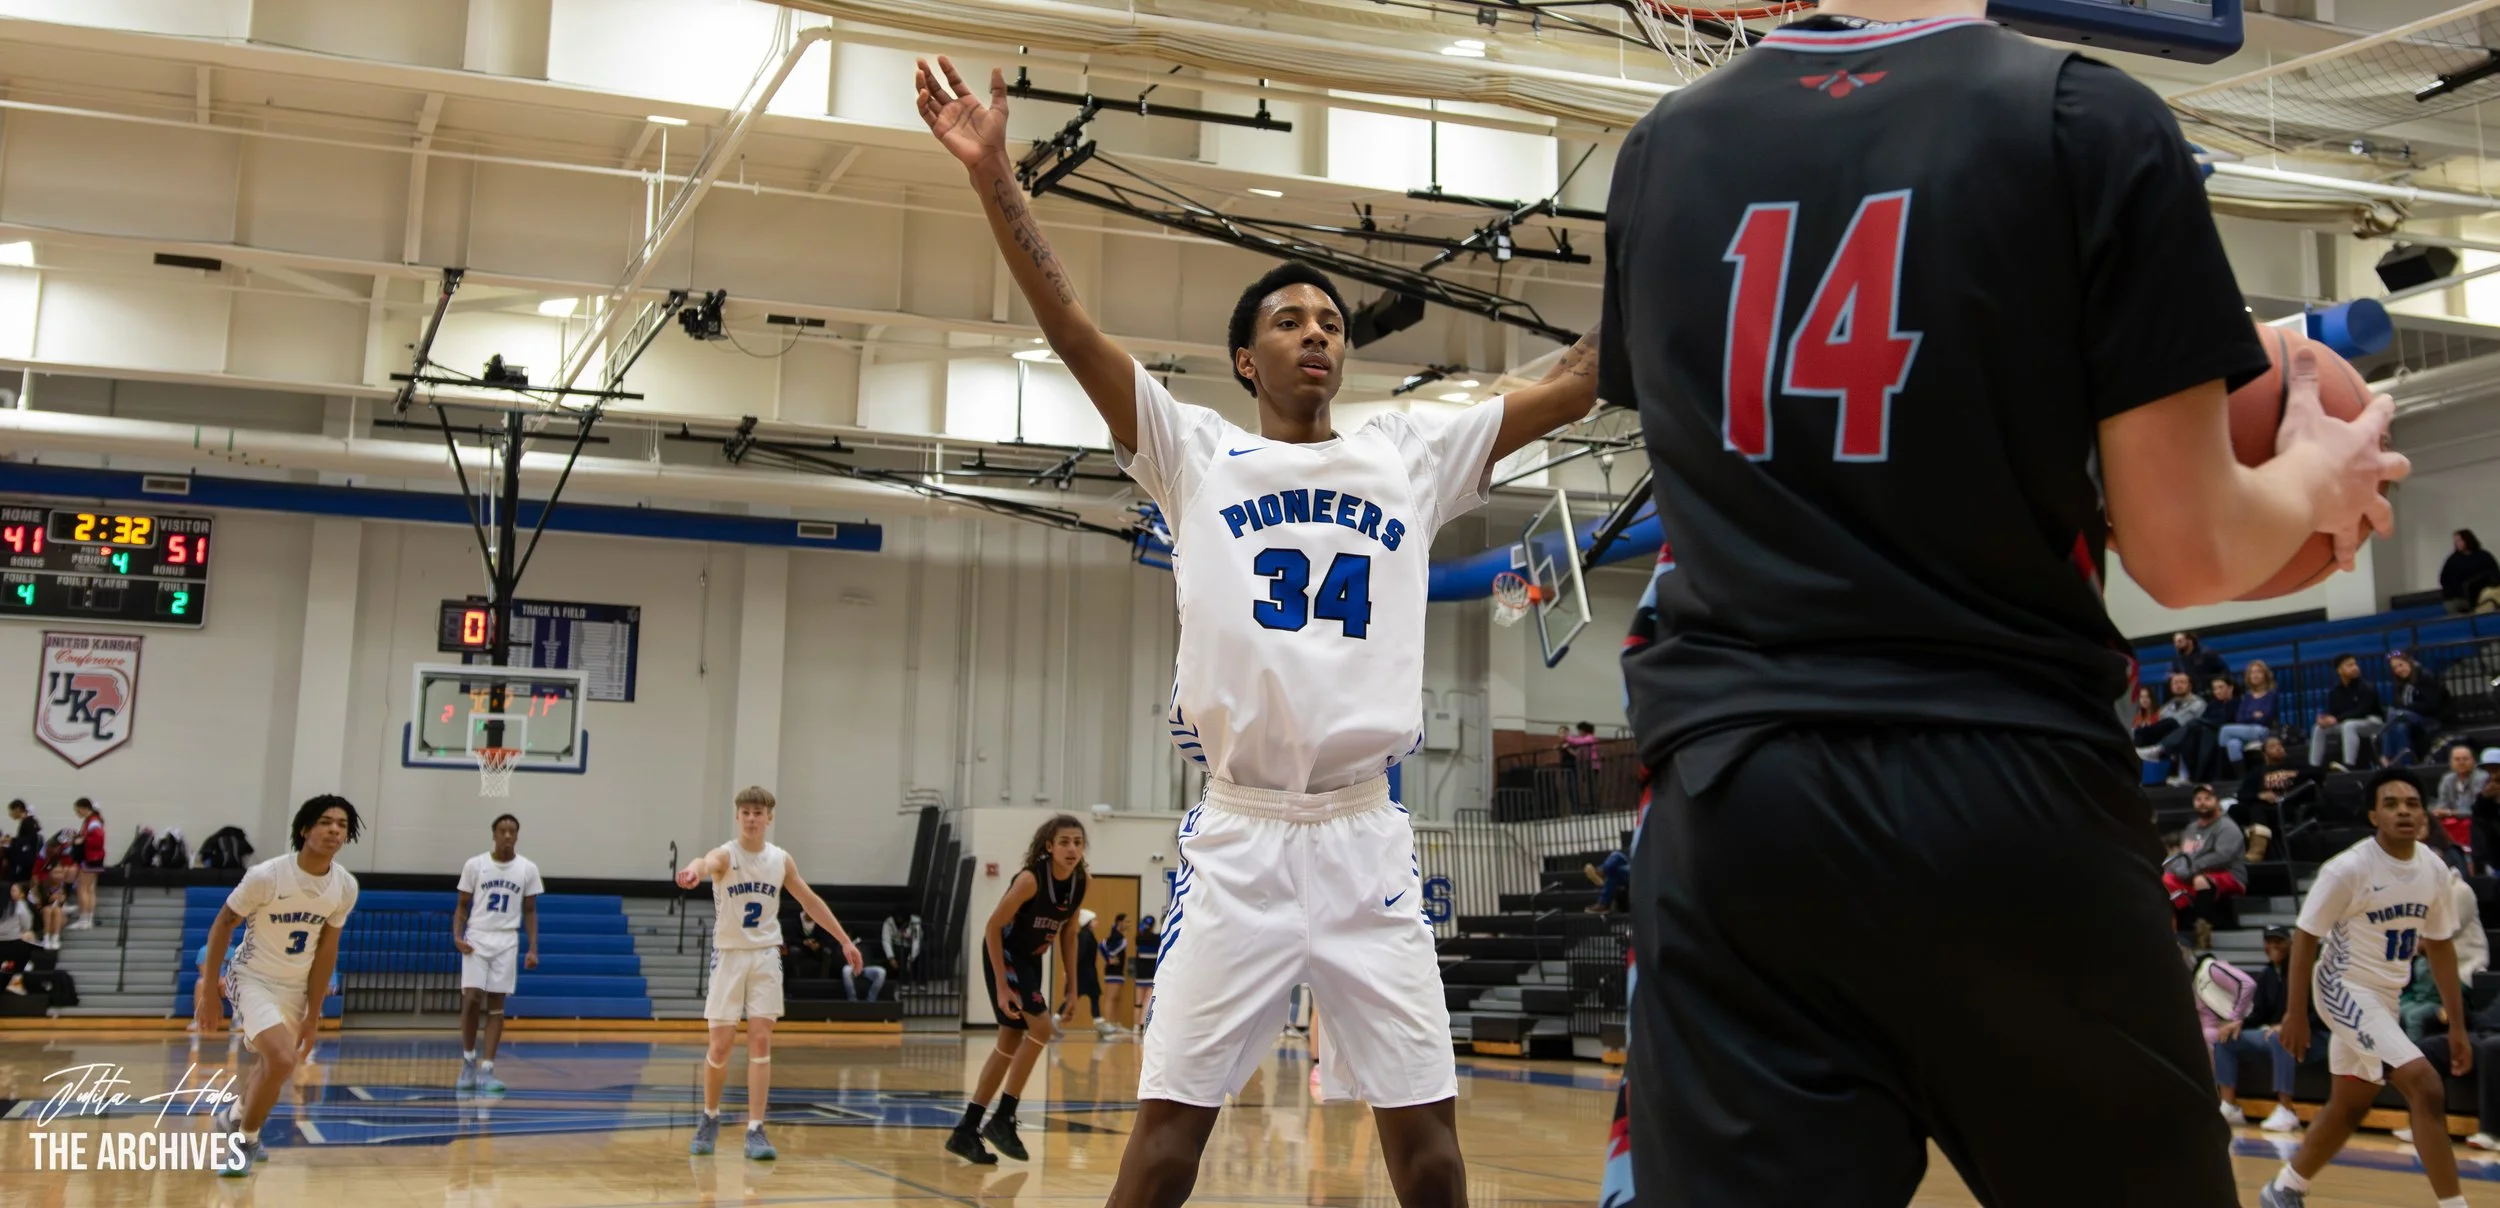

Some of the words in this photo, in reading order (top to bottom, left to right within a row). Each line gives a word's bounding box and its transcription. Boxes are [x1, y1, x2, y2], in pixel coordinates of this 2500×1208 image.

[1722, 188, 1924, 462] 14
[1, 508, 42, 523] HOME
[160, 519, 209, 533] VISITOR
[1219, 488, 1406, 552] PIONEERS
[74, 513, 151, 544] 2:32
[4, 525, 43, 554] 41
[167, 535, 206, 564] 51
[10, 556, 45, 568] BONUS
[72, 553, 107, 565] PERIOD
[112, 552, 129, 574] 4
[3, 573, 36, 583] FOULS
[153, 565, 186, 576] BONUS
[57, 576, 88, 587] FOULS
[92, 578, 129, 589] PLAYER
[158, 582, 189, 592] FOULS
[17, 583, 35, 605] 4
[171, 591, 189, 614] 2
[1253, 547, 1372, 640] 34
[522, 604, 550, 617] TRACK
[562, 607, 587, 619] FIELD
[464, 611, 486, 644] 0
[55, 648, 126, 668] Conference
[49, 671, 116, 741] UKC
[480, 879, 520, 895] PIONEERS
[727, 882, 777, 898] PIONEER
[486, 893, 509, 913] 21
[743, 902, 762, 928] 2
[285, 931, 308, 955] 3
[2385, 928, 2417, 961] 10
